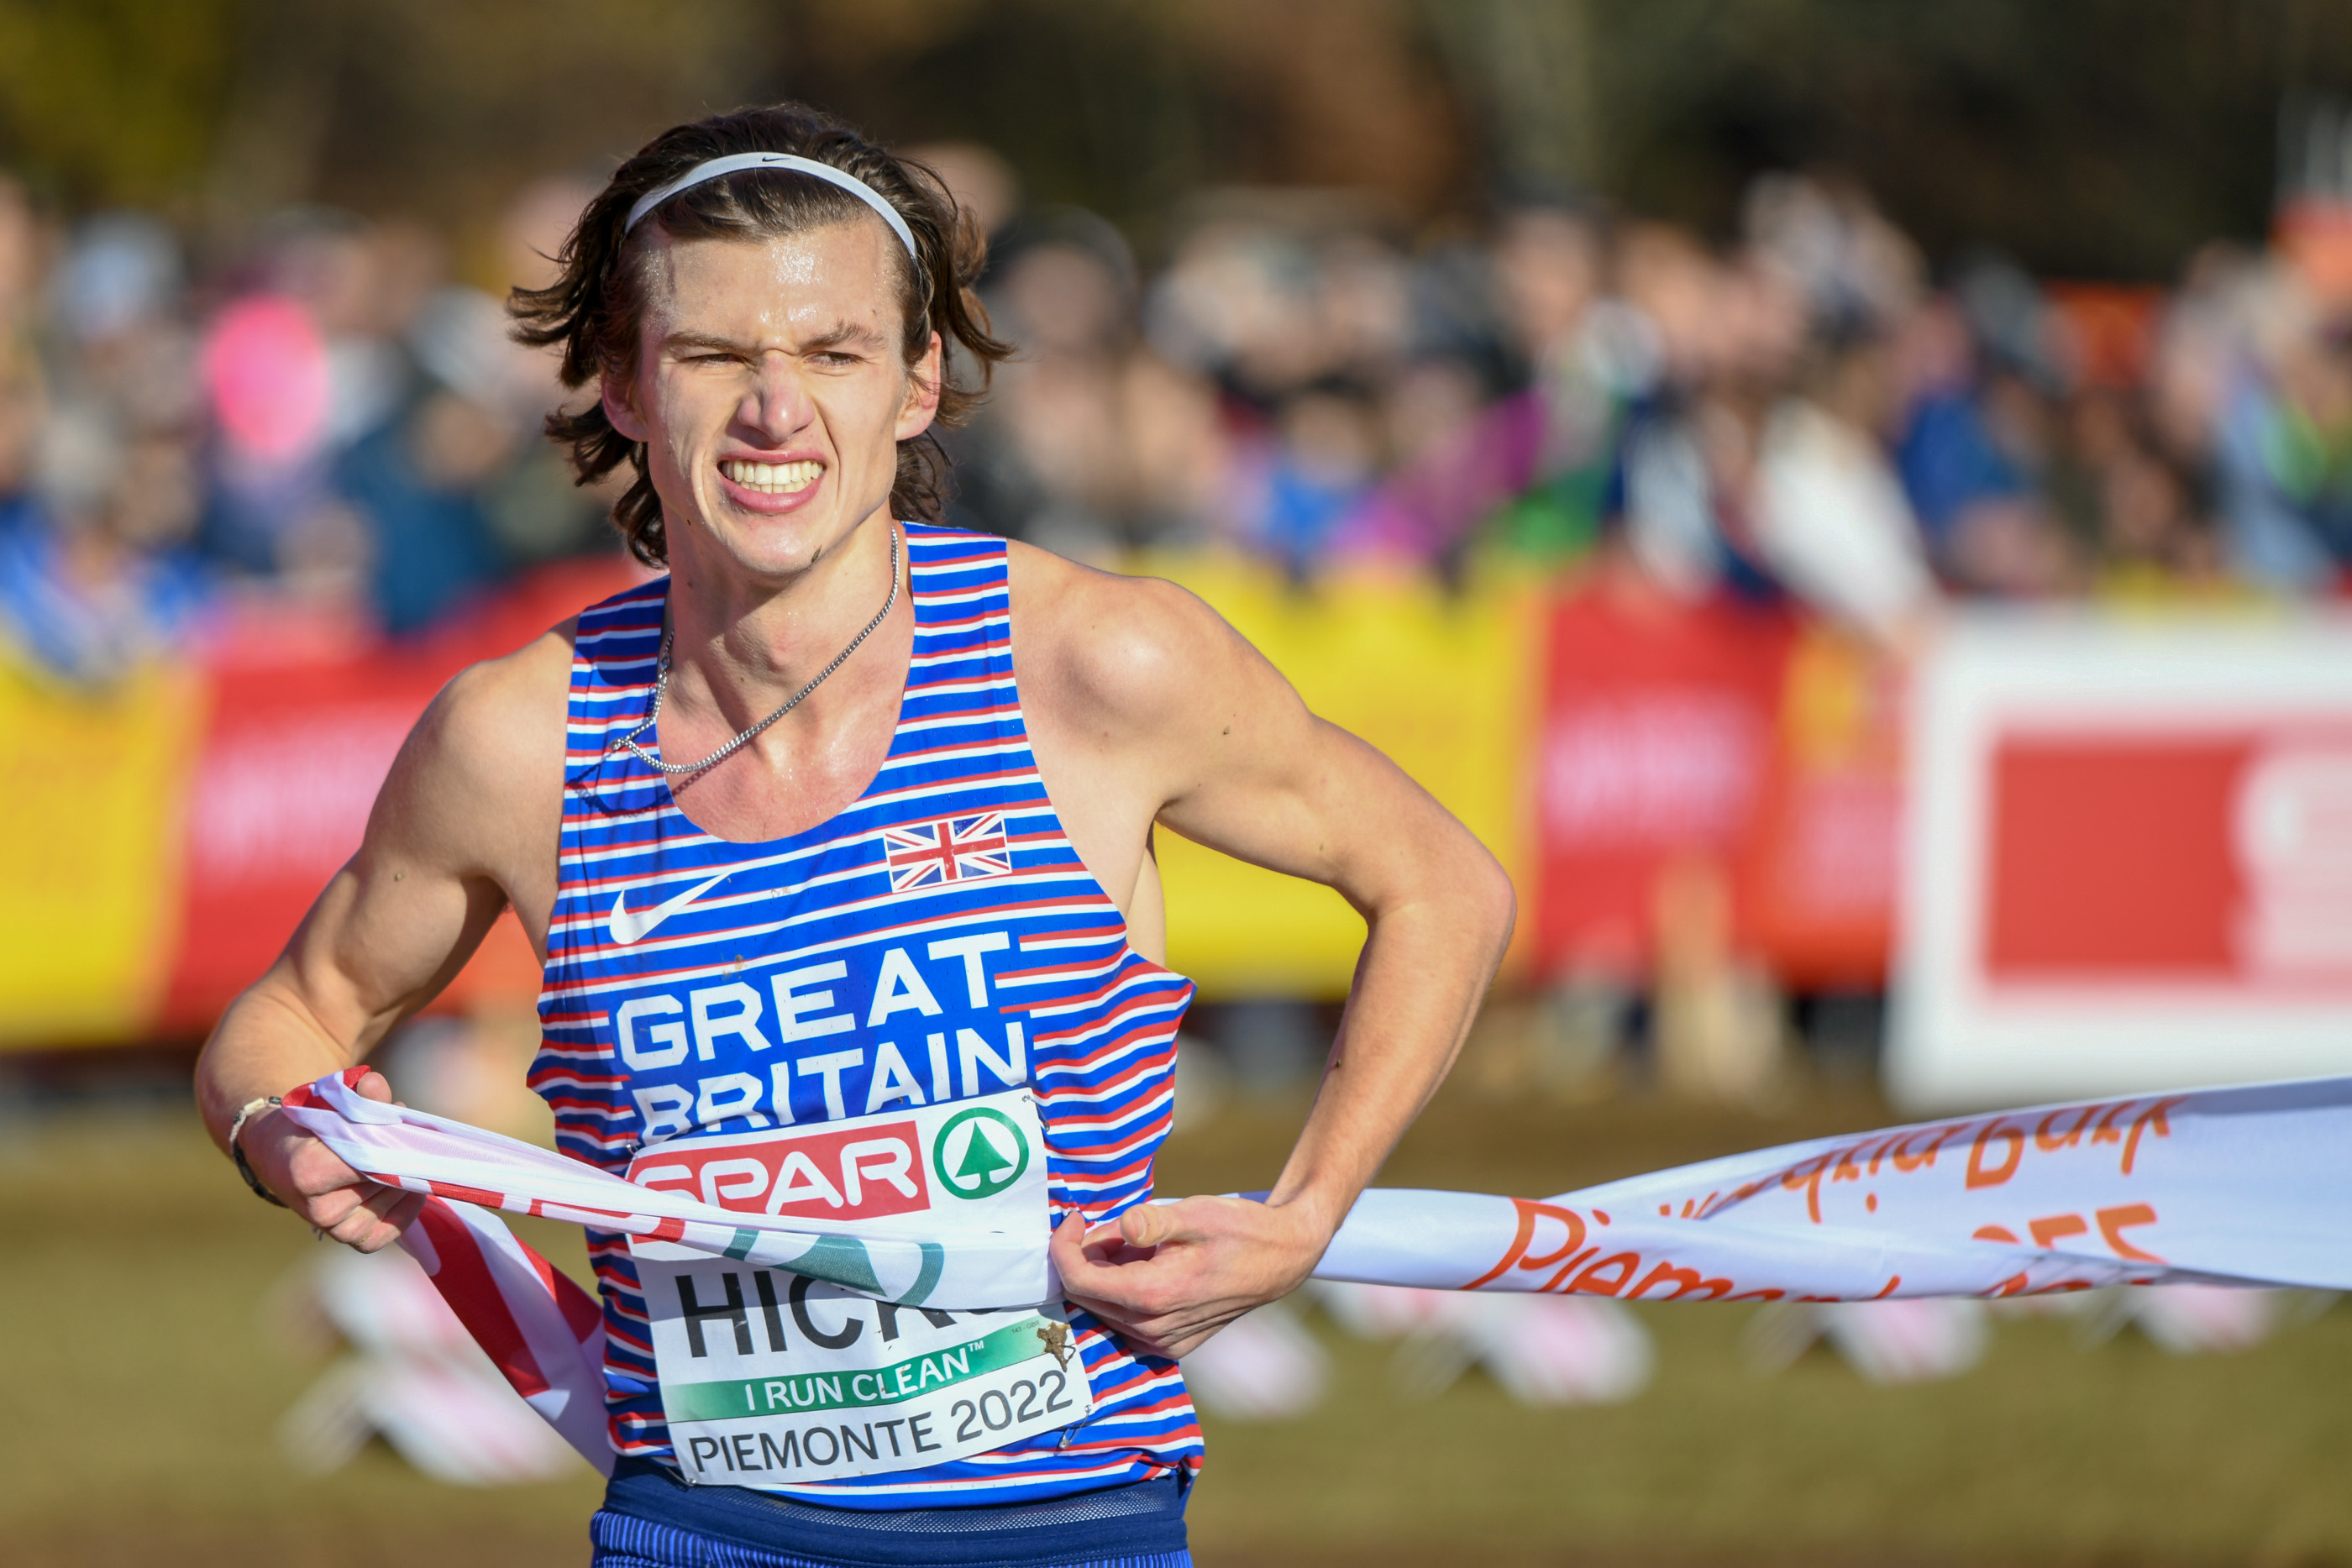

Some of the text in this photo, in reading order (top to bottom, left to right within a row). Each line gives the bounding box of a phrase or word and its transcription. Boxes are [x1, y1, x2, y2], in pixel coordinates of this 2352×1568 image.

[616, 931, 1011, 1072] GREAT
[632, 1021, 1029, 1147] BRITAIN
[675, 1268, 1004, 1358] HIC
[1026, 1320, 1041, 1329] GBR
[688, 1369, 1074, 1473] PIEMONTE 2022
[744, 1383, 756, 1411] I
[766, 1375, 843, 1410] RUN
